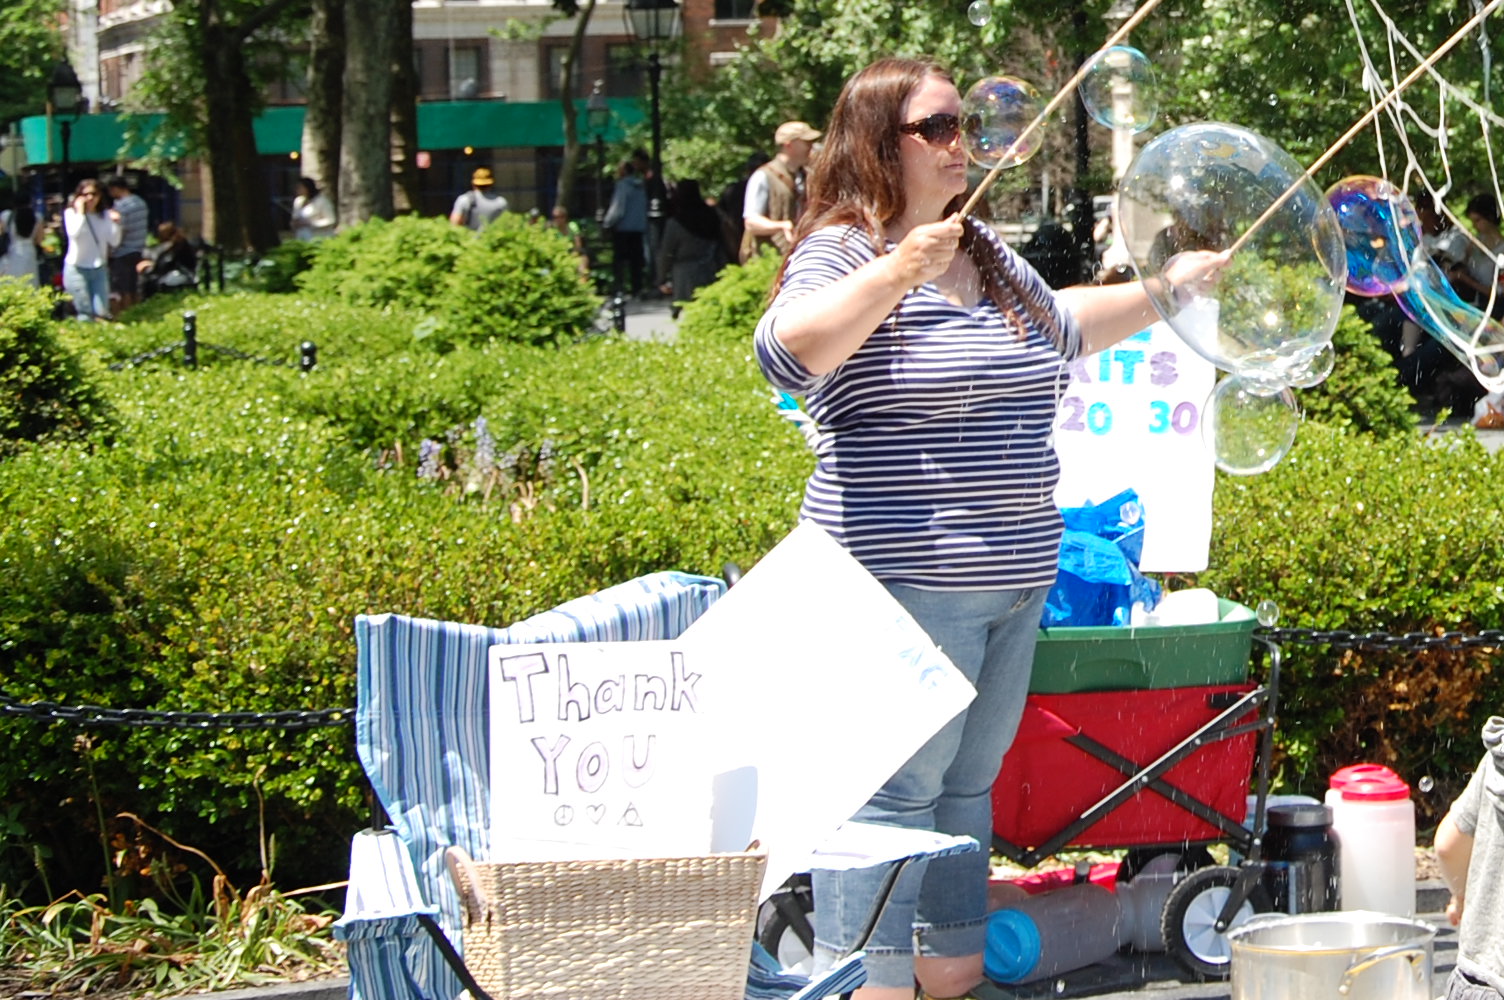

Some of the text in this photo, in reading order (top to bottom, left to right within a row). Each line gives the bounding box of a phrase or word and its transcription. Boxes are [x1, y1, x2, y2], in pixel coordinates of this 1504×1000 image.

[1060, 396, 1198, 436] 20 30
[499, 652, 702, 723] Thank
